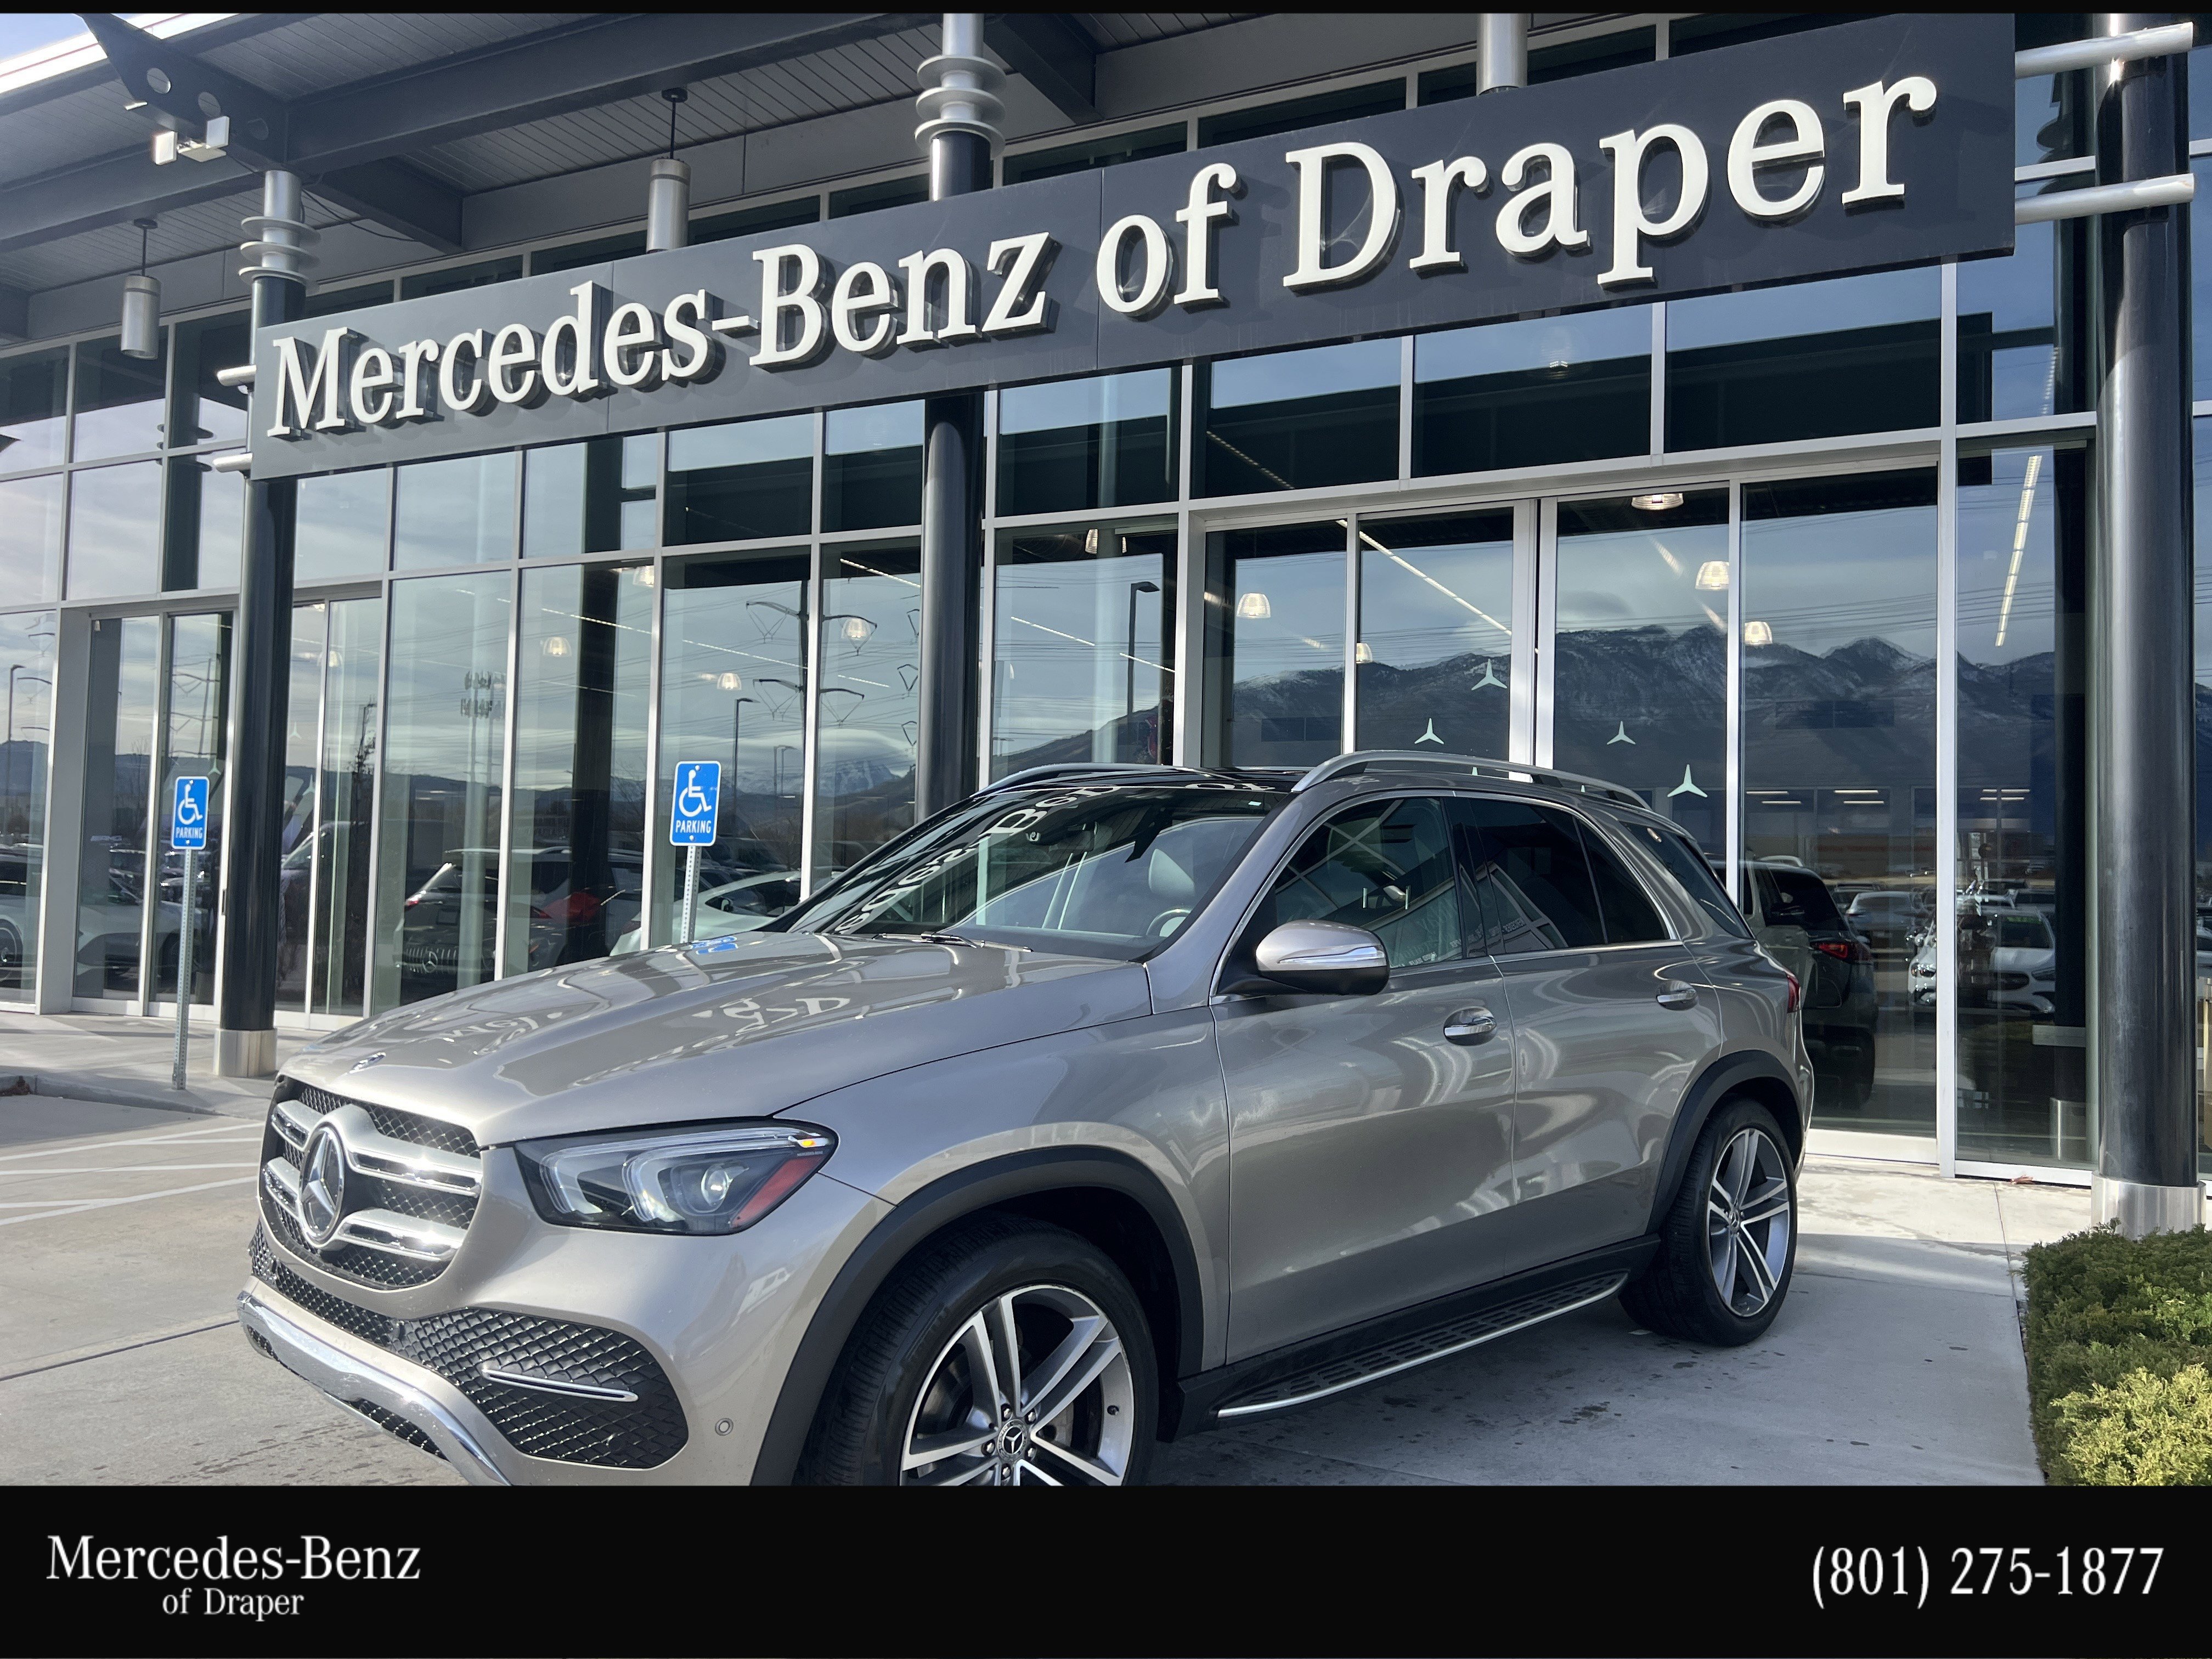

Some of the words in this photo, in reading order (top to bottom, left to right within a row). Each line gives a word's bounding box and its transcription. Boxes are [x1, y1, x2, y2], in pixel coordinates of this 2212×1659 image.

[266, 232, 1054, 439] Mercedes-Benz
[1097, 162, 1239, 316] of
[1283, 75, 1938, 289] Draper
[176, 827, 203, 839] PARKING
[675, 820, 712, 833] PARKING
